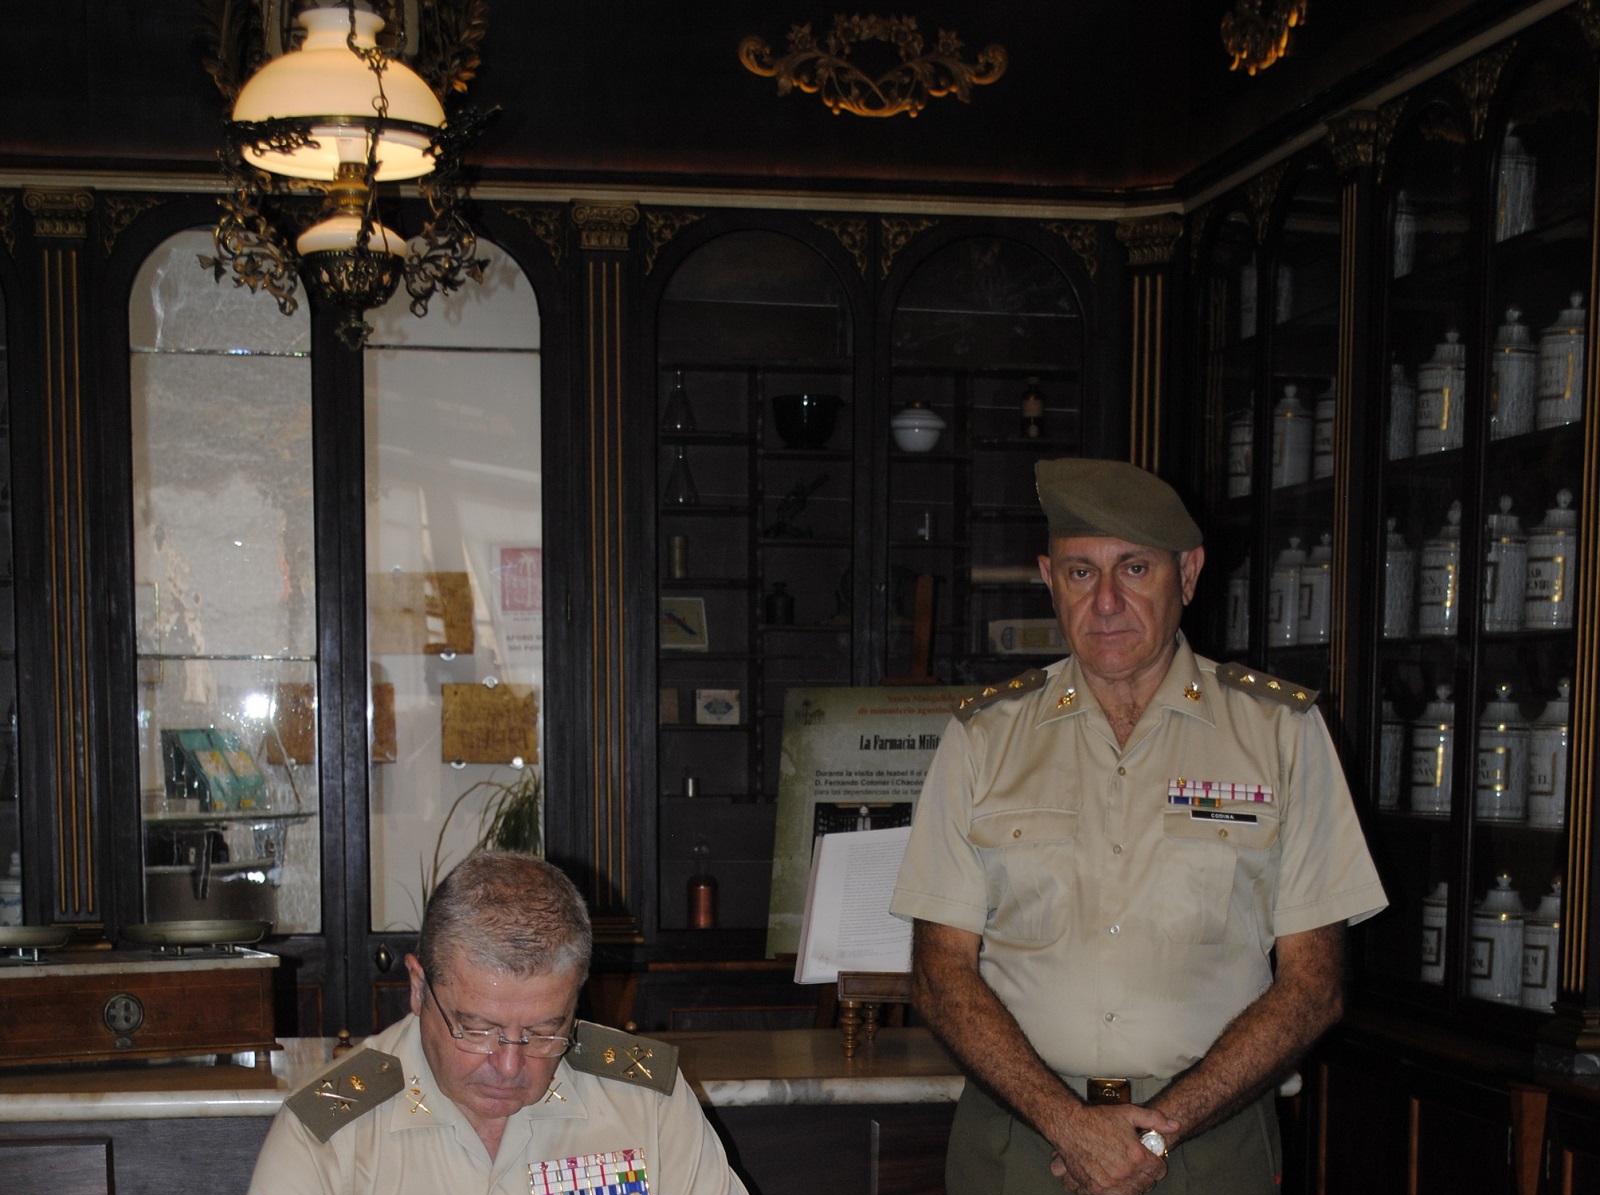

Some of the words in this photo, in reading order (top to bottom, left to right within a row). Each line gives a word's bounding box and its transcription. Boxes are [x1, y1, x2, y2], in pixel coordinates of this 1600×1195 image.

[860, 735, 871, 750] La
[874, 734, 916, 750] Farmacia
[846, 769, 853, 777] la
[854, 769, 874, 777] visita
[875, 769, 885, 777] de
[813, 789, 830, 797] para
[842, 787, 890, 797] dependencias
[891, 787, 901, 796] de
